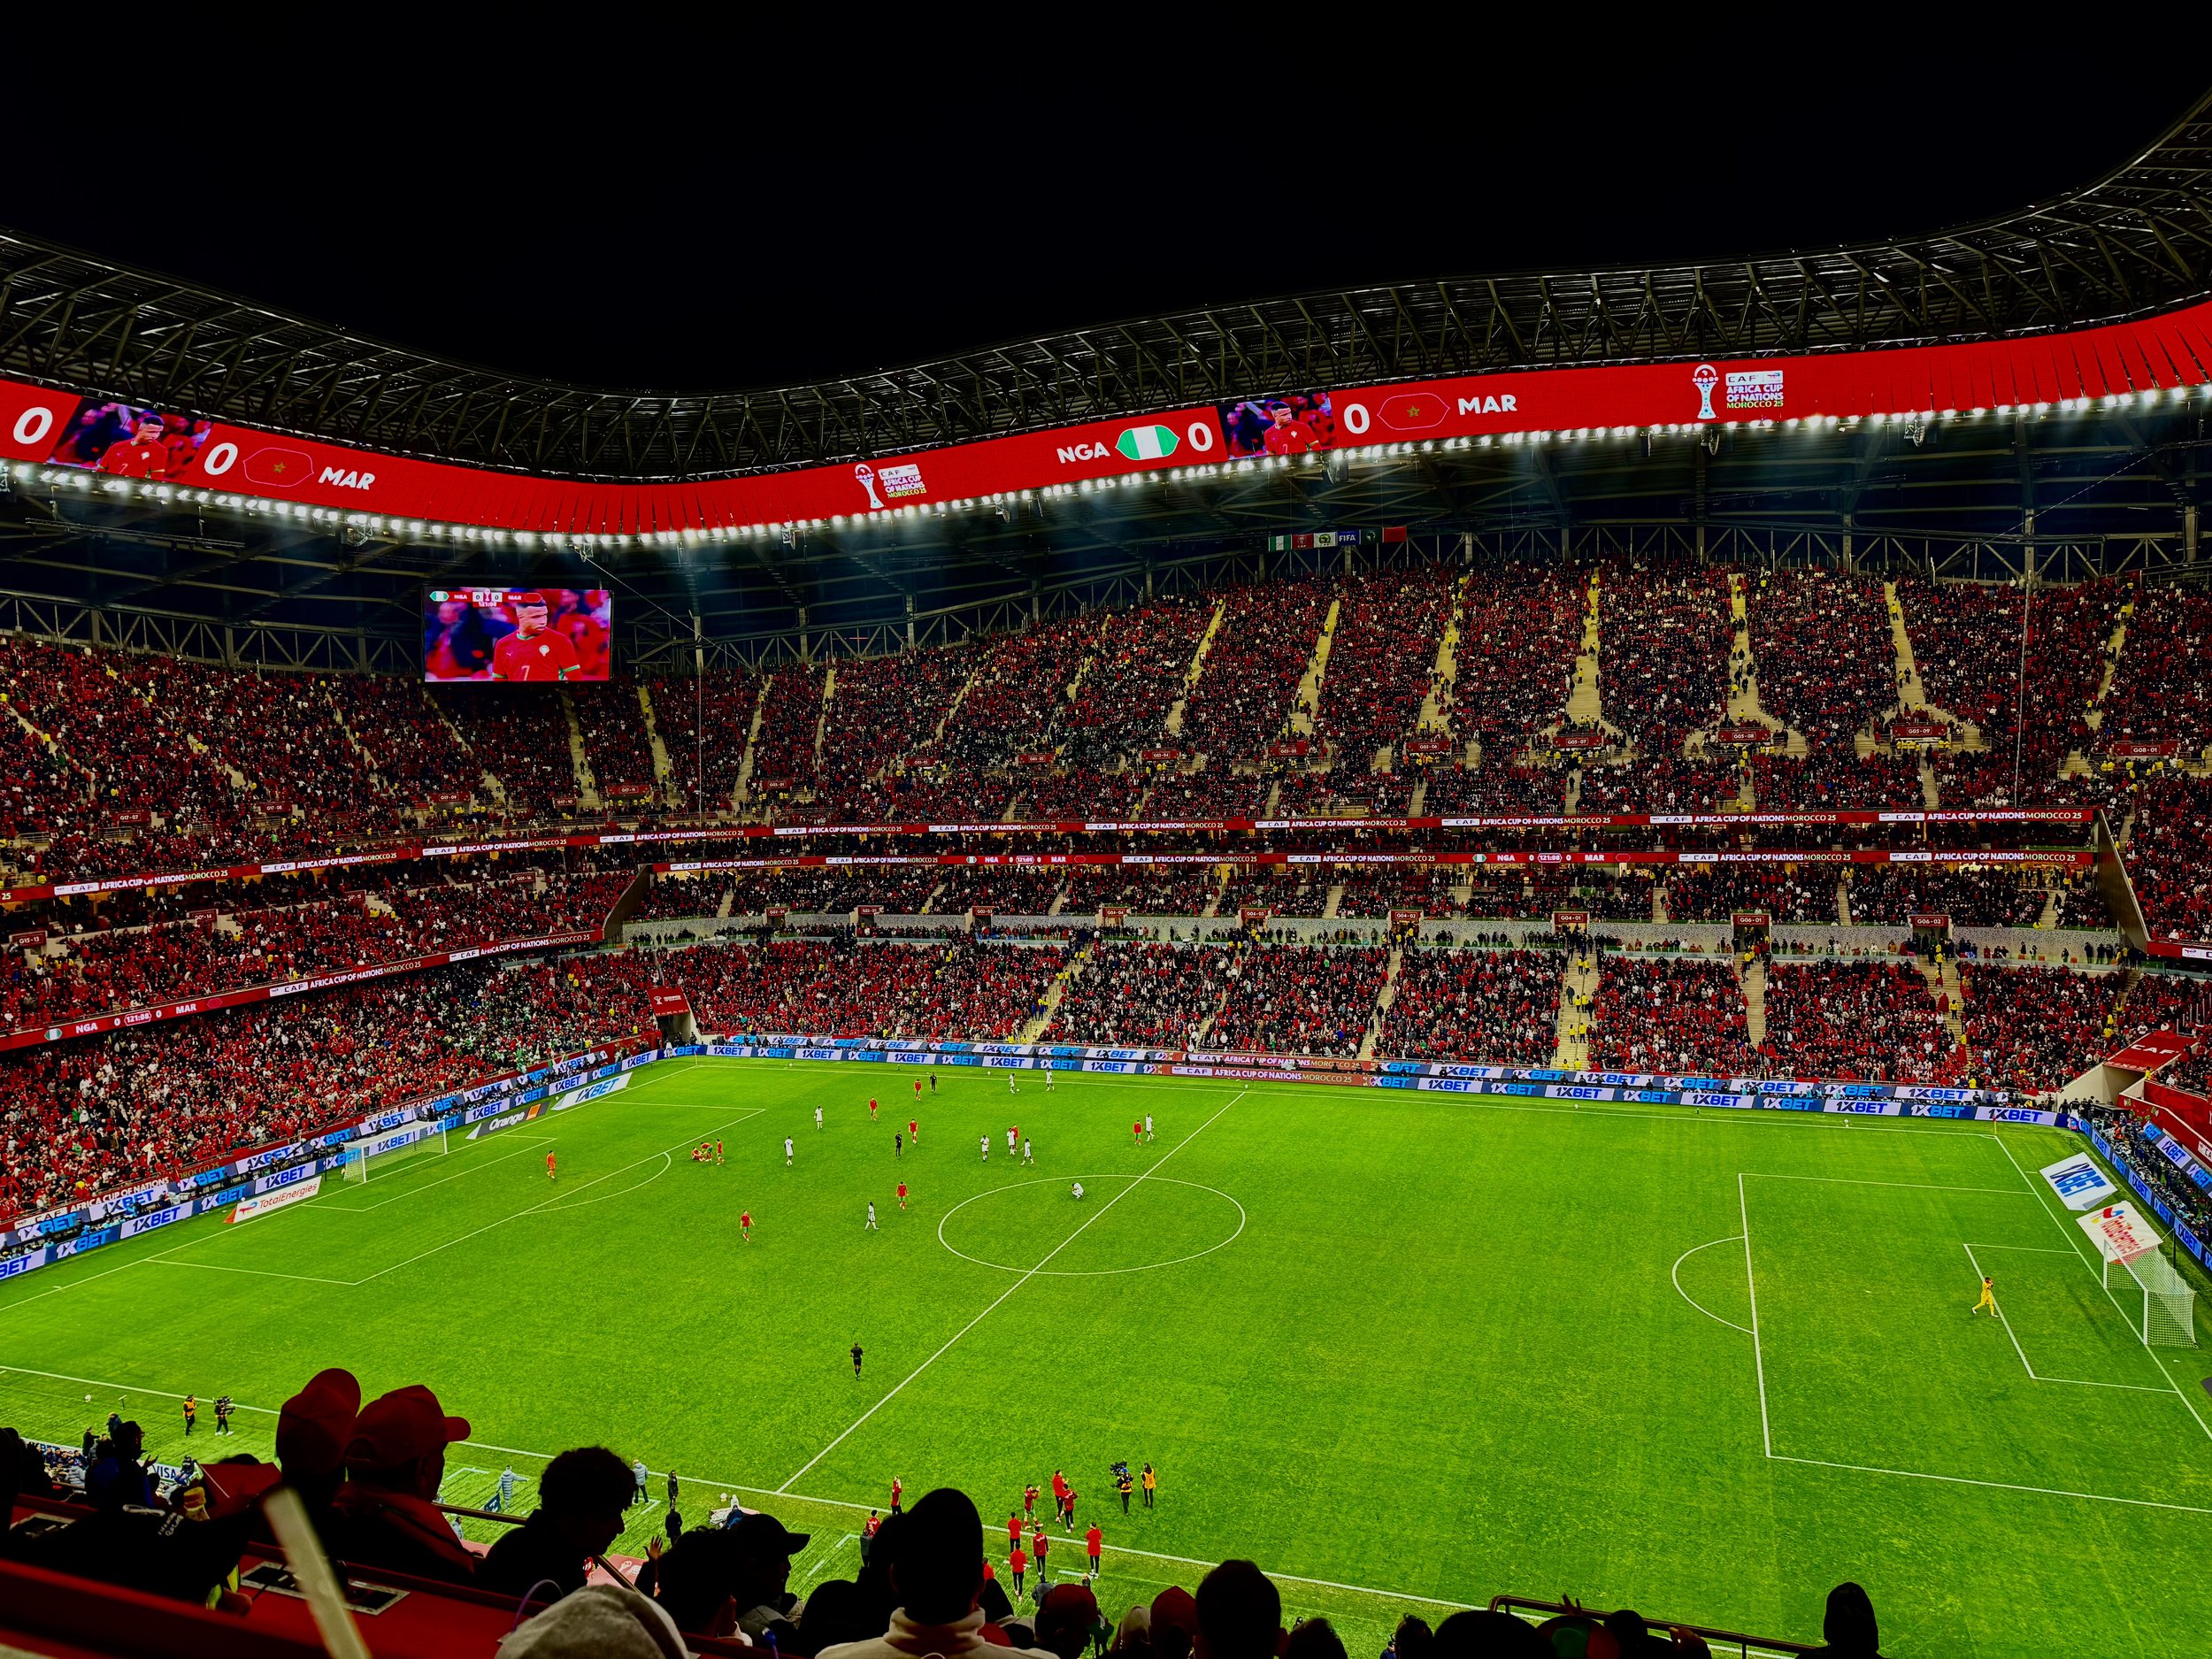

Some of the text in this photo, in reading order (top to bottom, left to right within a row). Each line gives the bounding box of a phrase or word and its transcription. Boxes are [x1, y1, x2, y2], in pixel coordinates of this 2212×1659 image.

[1740, 392, 1784, 402] NATIONS
[1763, 384, 1784, 393] CUP
[1343, 394, 1517, 434] 0 MAR
[13, 407, 53, 444] 0
[1056, 422, 1213, 464] NGA 0
[204, 442, 375, 490] 0 MAR
[310, 978, 334, 988] AFRICA
[334, 975, 348, 986] CUP
[357, 968, 383, 979] NATIONS
[384, 963, 414, 973] MOROCCO
[76, 1023, 97, 1033] NGA
[127, 1013, 150, 1024] 121:08
[176, 1003, 196, 1014] MAR
[713, 1046, 744, 1055] 1XBET
[2131, 1043, 2177, 1054] CAF
[626, 1053, 650, 1066] 1XBET
[894, 1053, 927, 1063] 1XBET
[1091, 1062, 1127, 1071] 1XBET
[555, 1075, 580, 1092] 1XBET
[1271, 1071, 1302, 1080] NATIONS
[1302, 1073, 1341, 1082] MOROCCO
[1428, 1079, 1471, 1091] 1XBET
[1663, 1077, 1718, 1089] 1XBET
[575, 1078, 619, 1102] 1XBET
[1491, 1083, 1536, 1095] 1XBET
[1555, 1087, 1601, 1098] 1XBET
[1623, 1091, 1671, 1103] 1XBET
[1909, 1088, 1968, 1100] 1XBET
[1692, 1094, 1741, 1106] 1XBET
[1763, 1097, 1814, 1110] 1XBET
[1836, 1101, 1888, 1114] 1XBET
[472, 1102, 502, 1119] 1XBET
[1911, 1104, 1964, 1118] 1XBET
[1988, 1108, 2043, 1122] 1XBET
[488, 1111, 525, 1131] Orange
[377, 1131, 411, 1150] 1XBET
[2162, 1141, 2186, 1163] 1XBET
[178, 1167, 225, 1189] 1XBET
[265, 1165, 306, 1189] 1XBET
[2050, 1162, 2107, 1197] 1XBET
[70, 1197, 102, 1213] AFRICA
[103, 1191, 121, 1205] CUP
[121, 1187, 133, 1197] OF
[133, 1177, 170, 1193] NATIONS
[202, 1186, 247, 1208] 1XBET
[259, 1182, 318, 1209] TotalEnergies
[18, 1213, 77, 1241] 1XBET
[133, 1206, 180, 1233] 1XBET
[56, 1229, 110, 1258] 1XBET
[2177, 1224, 2198, 1251] 1XBET
